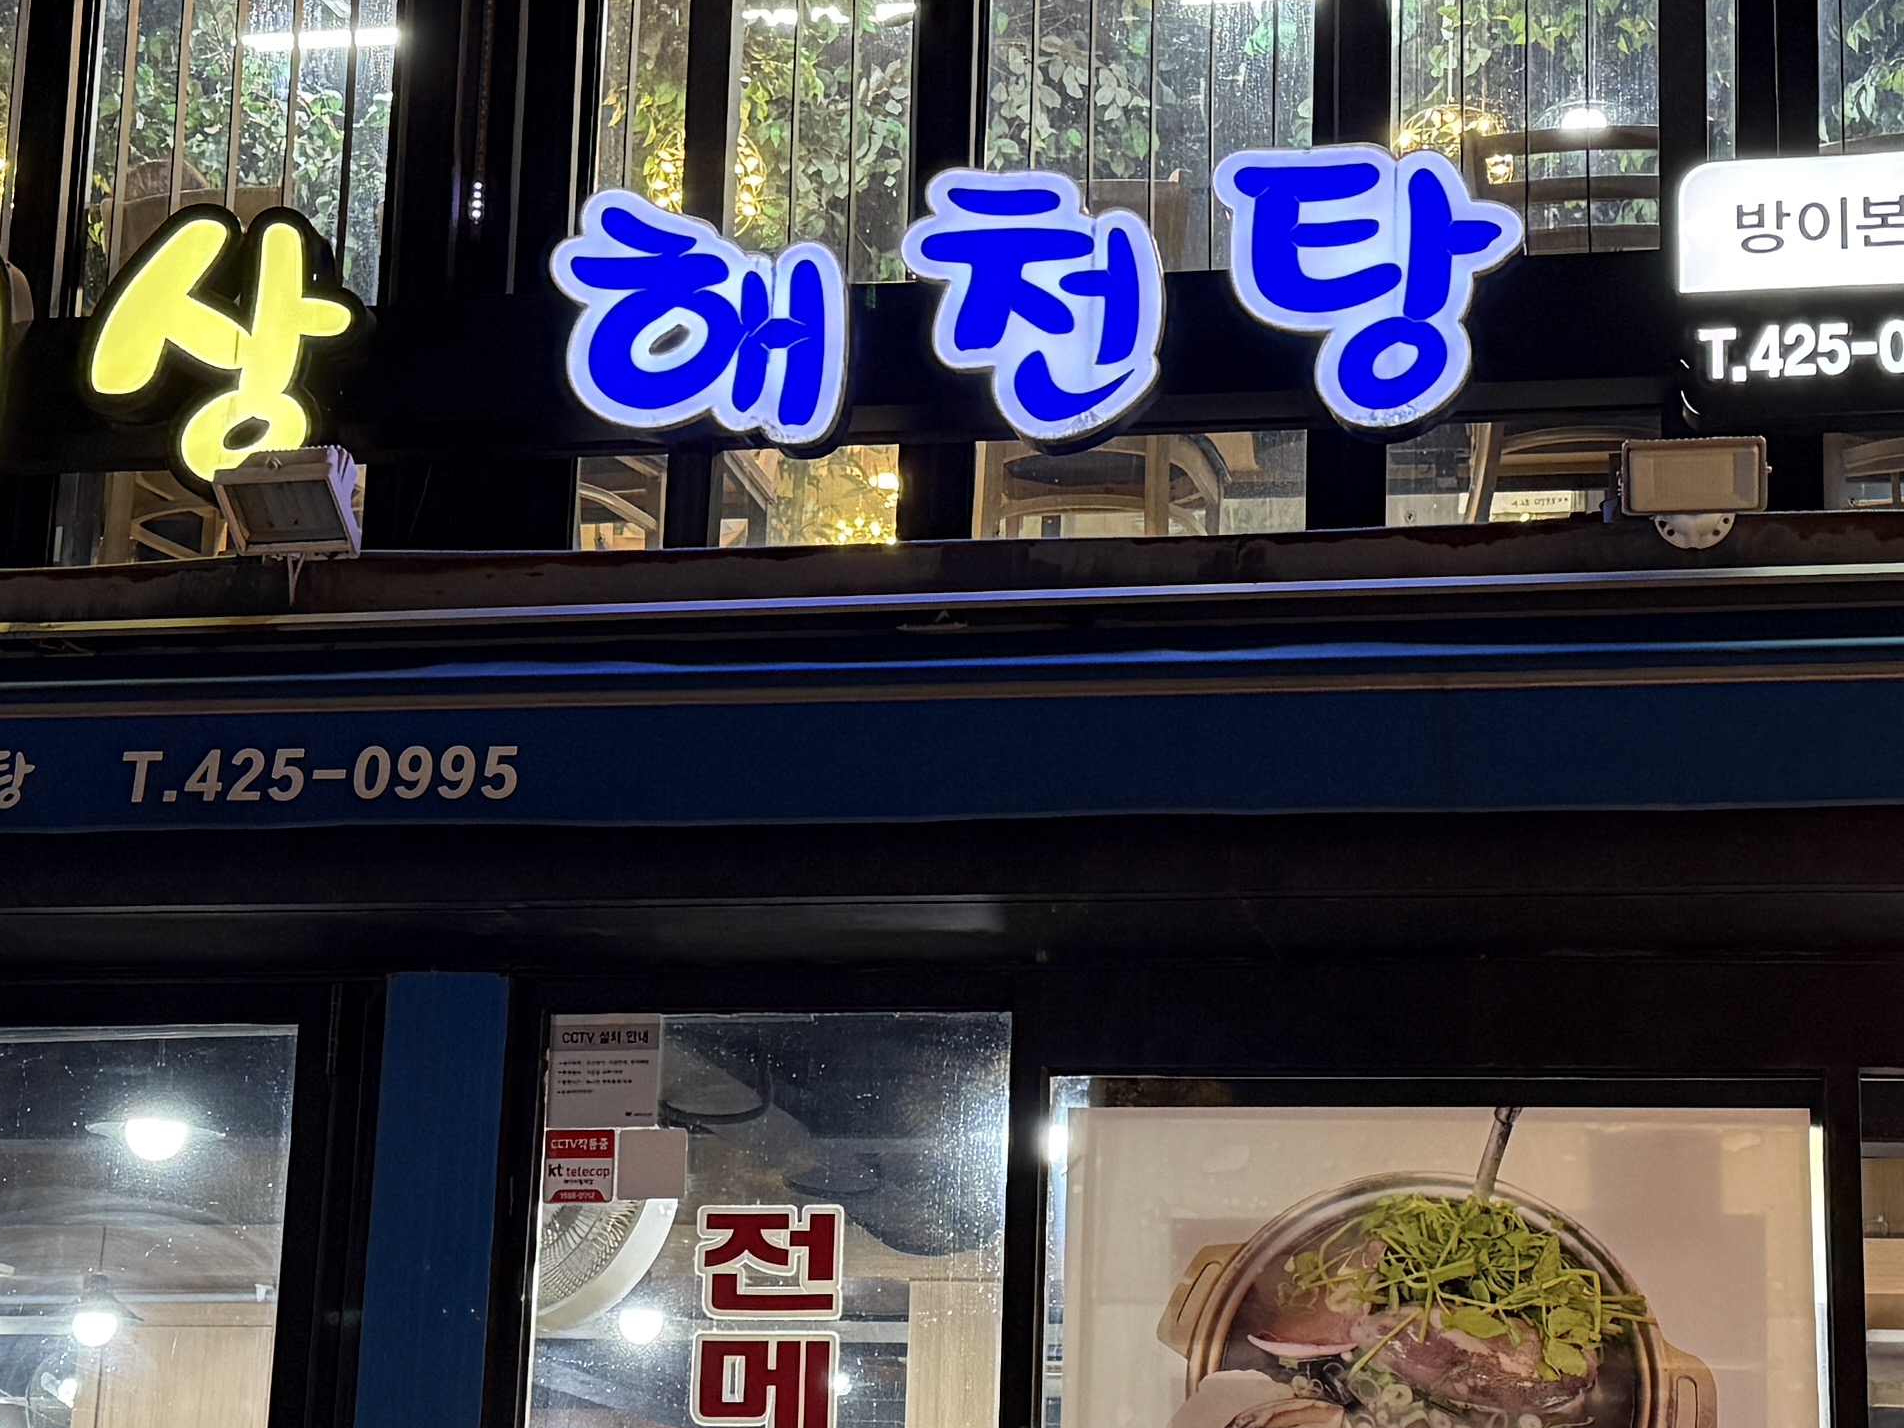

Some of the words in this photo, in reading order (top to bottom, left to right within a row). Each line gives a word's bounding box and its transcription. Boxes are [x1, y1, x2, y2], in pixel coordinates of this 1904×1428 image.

[558, 148, 1518, 442] 해천탕
[121, 745, 521, 804] T.425-0995
[562, 1032, 595, 1044] CCTV
[600, 1030, 621, 1044] 설치
[626, 1030, 649, 1044] 안내
[548, 1163, 564, 1177] kt
[566, 1165, 610, 1179] telecop
